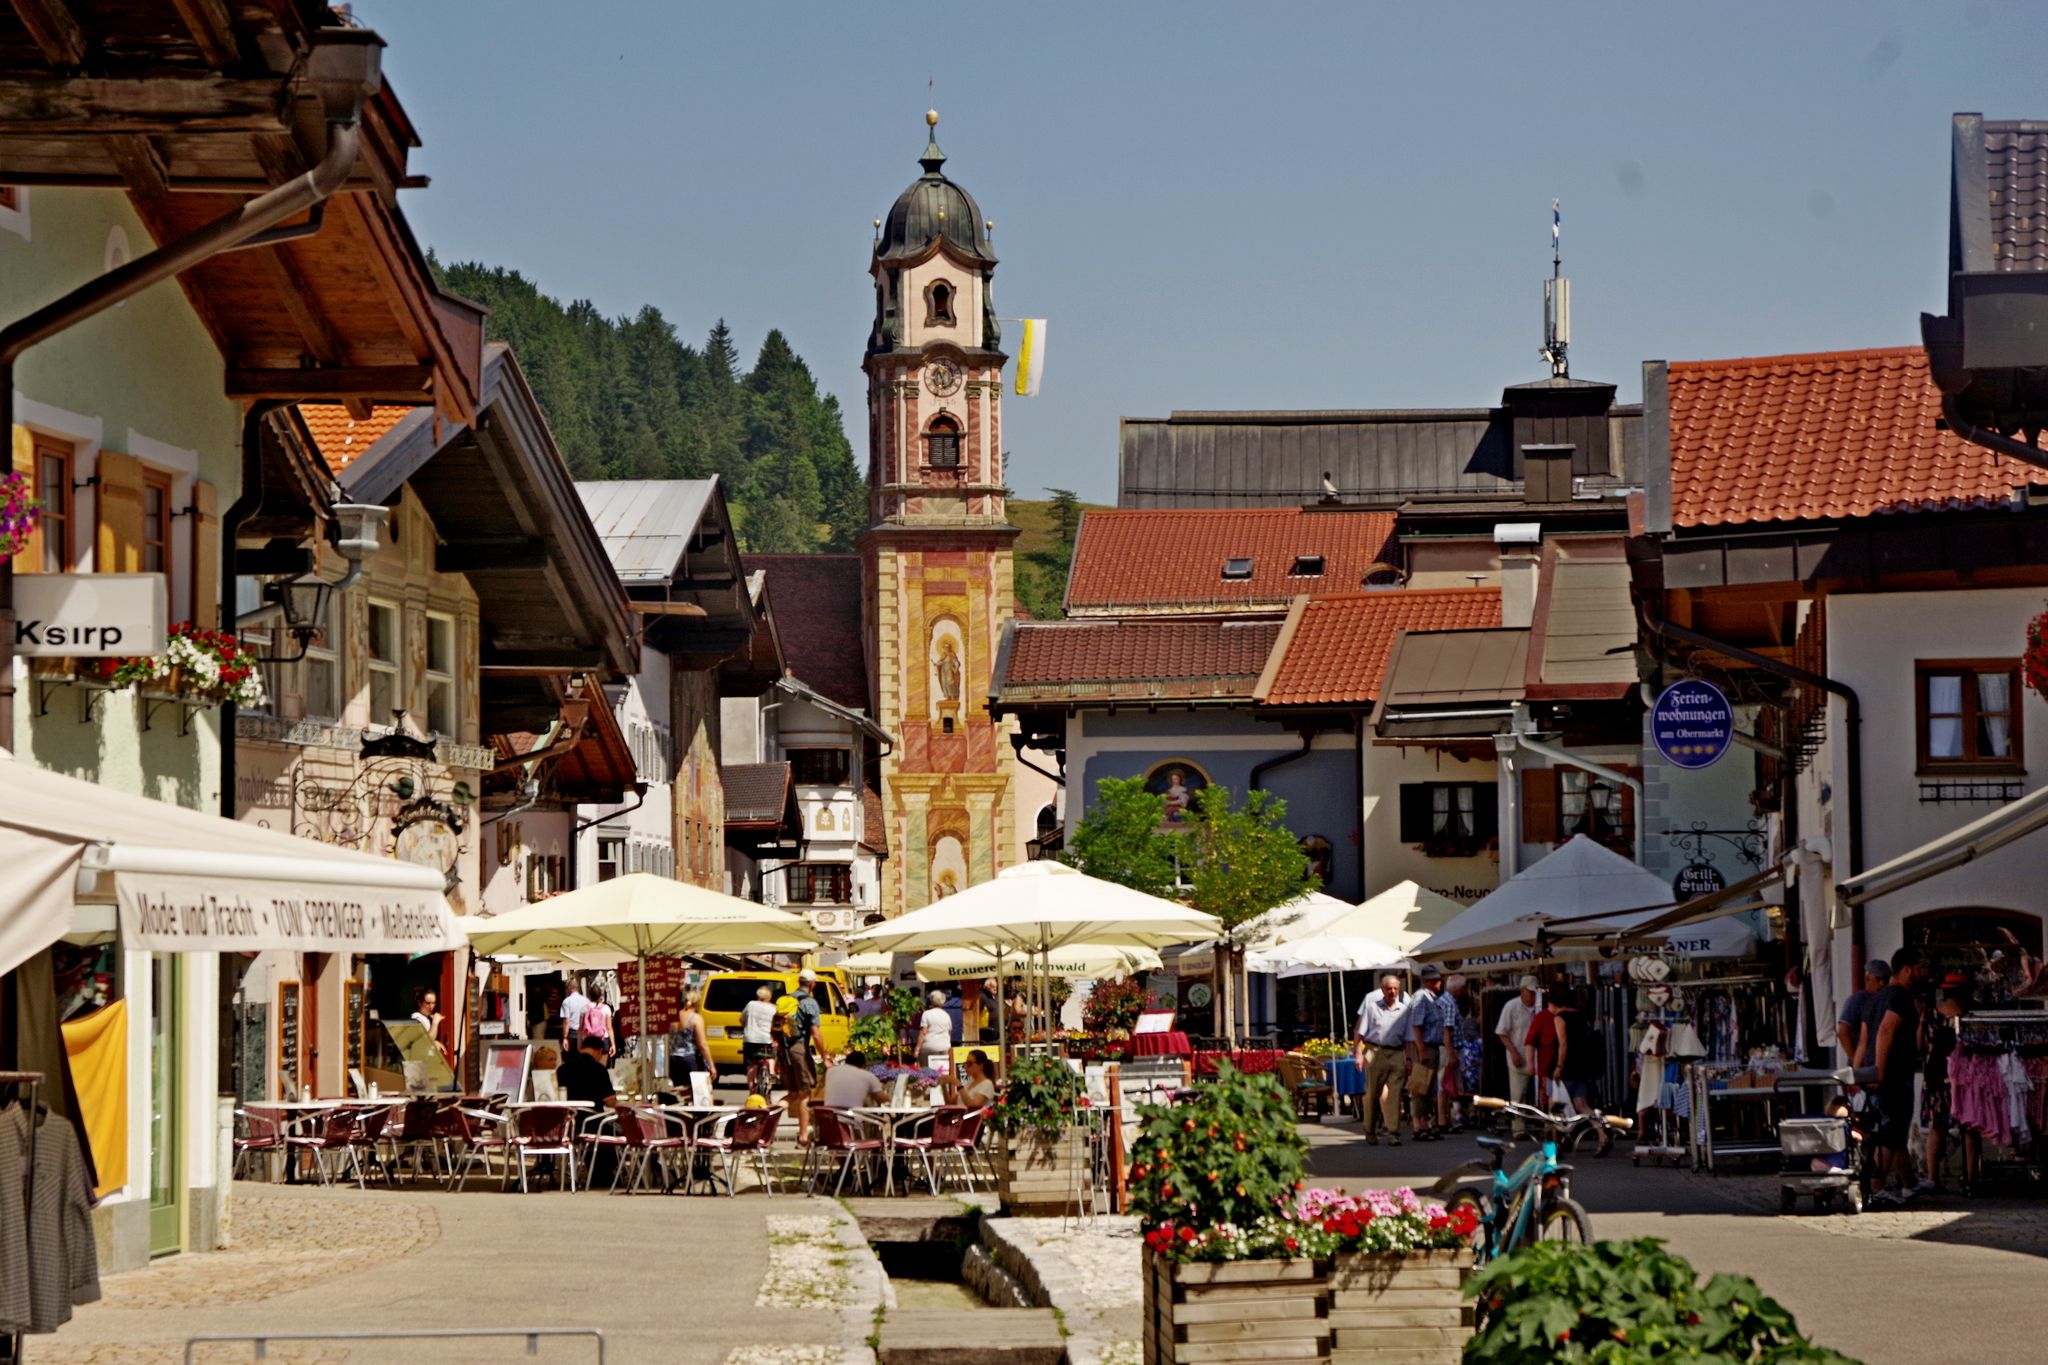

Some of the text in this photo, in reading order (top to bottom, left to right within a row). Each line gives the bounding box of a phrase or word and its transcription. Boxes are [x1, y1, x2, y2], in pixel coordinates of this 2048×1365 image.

[1669, 690, 1713, 707] Ferien-
[1657, 708, 1726, 723] wohnungen
[1660, 728, 1725, 739] am Obermarkt
[1682, 868, 1717, 880] Grill-
[1680, 879, 1720, 892] Stub'n
[137, 891, 178, 935] Mode
[180, 893, 208, 936] und
[209, 894, 258, 936] Tracht
[305, 900, 365, 938] SPRENGER
[626, 960, 661, 972] Frche
[948, 961, 1086, 976] Brauere Mitenwald
[622, 972, 663, 983] Erder-
[622, 981, 666, 994] schtten
[629, 1002, 658, 1014] Frch
